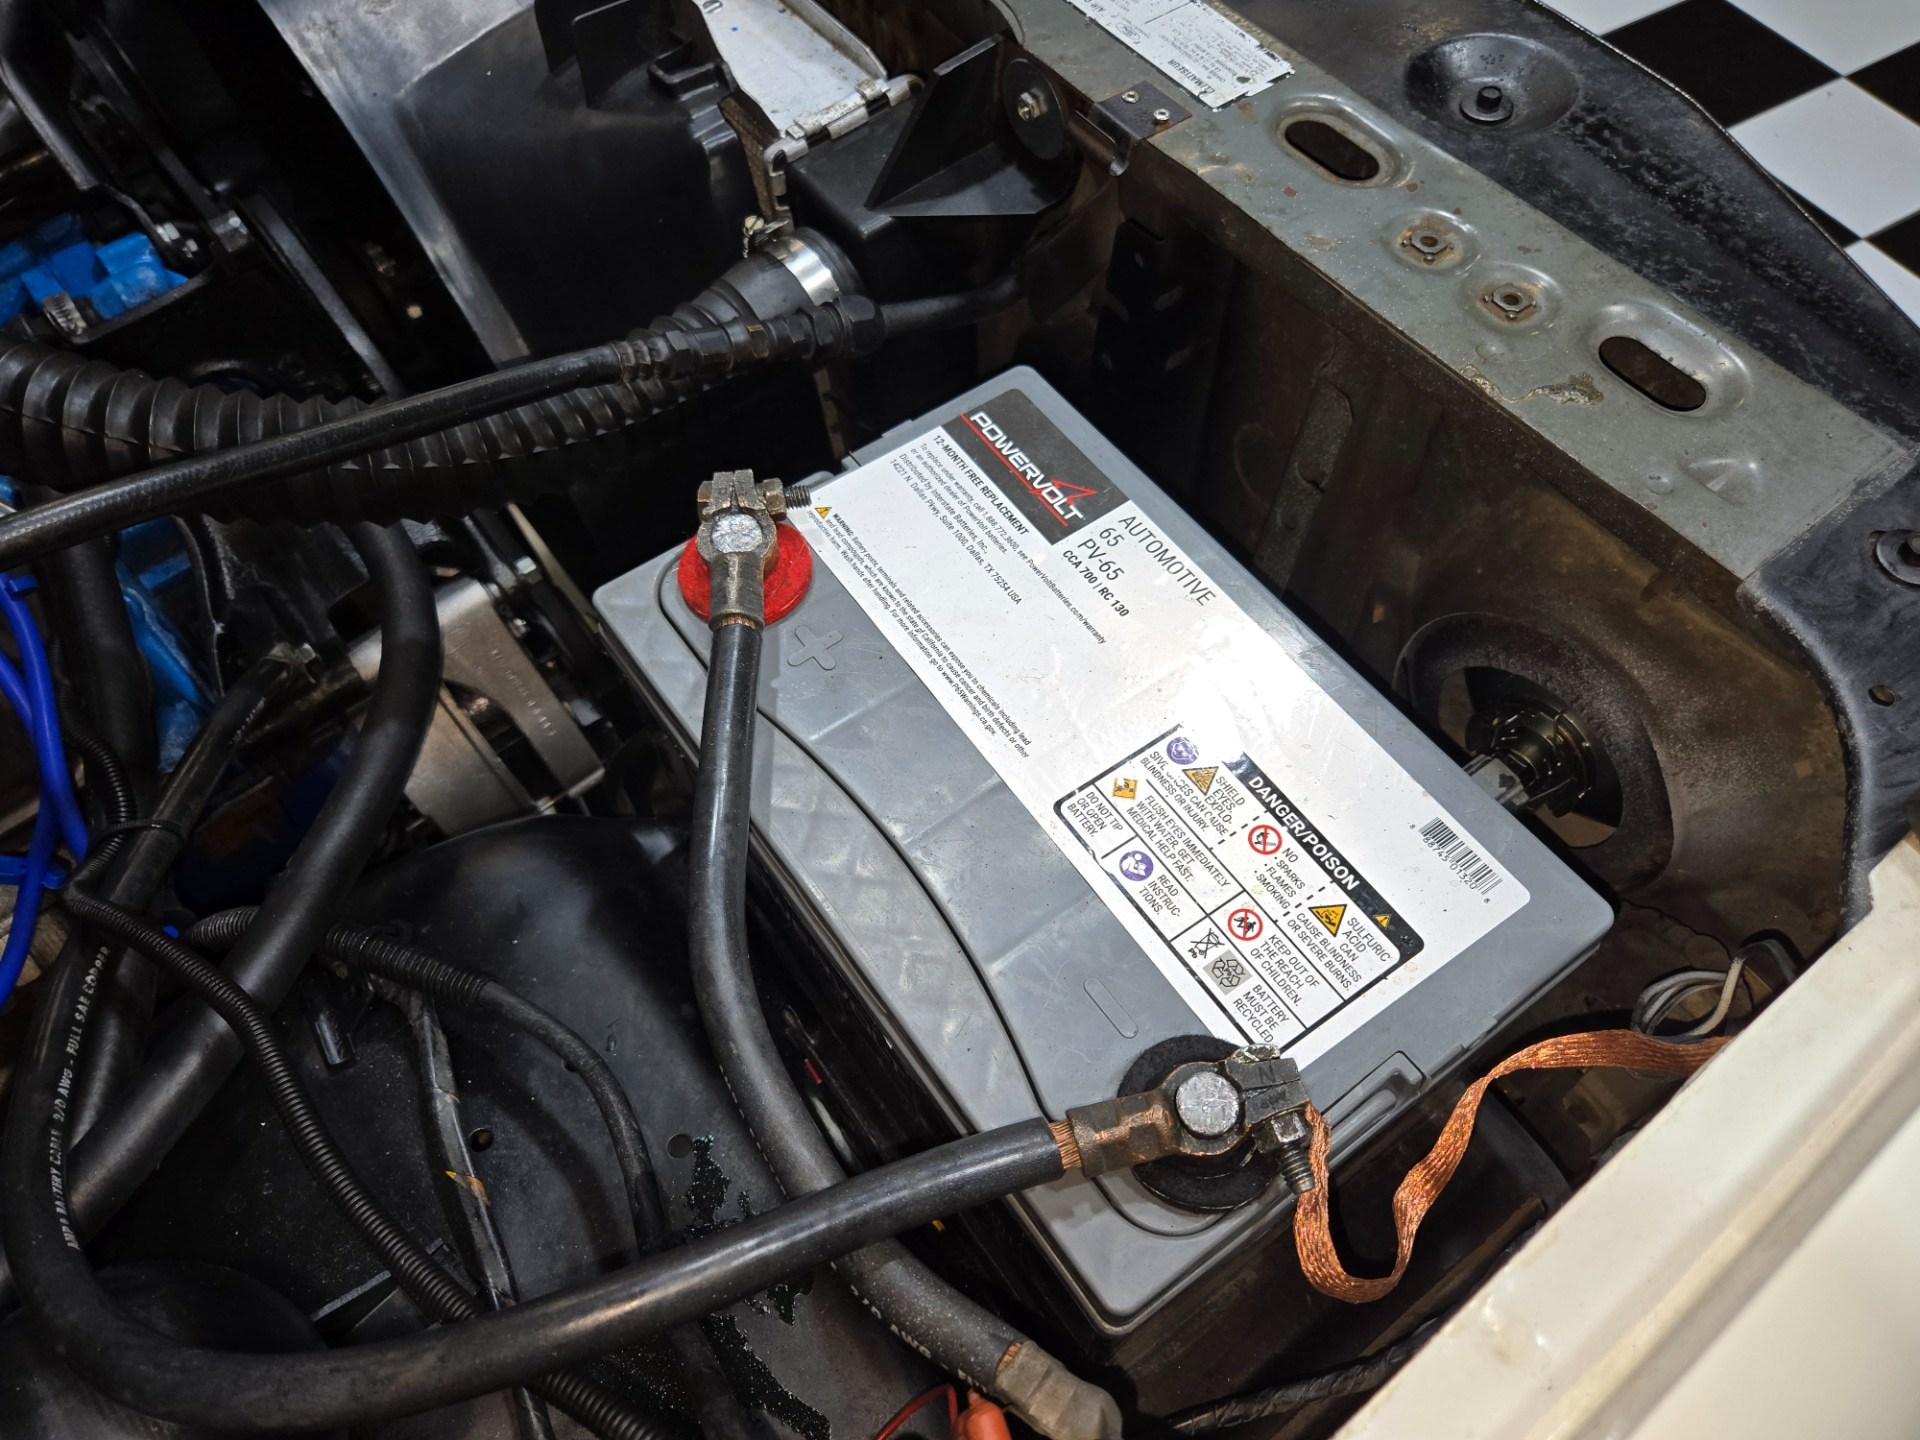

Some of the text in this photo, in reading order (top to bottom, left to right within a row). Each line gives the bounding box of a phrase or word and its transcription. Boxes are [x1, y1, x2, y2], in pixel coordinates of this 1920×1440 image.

[1167, 58, 1216, 95] CLIMATISEUR
[933, 434, 1029, 535] 12-MONTH FREE REPLACEMENT
[970, 412, 1082, 519] POWERVOLT
[898, 453, 929, 483] Distributed
[923, 480, 934, 491] by
[930, 488, 956, 515] Interstate
[952, 513, 978, 542] Batteries,
[909, 447, 1008, 555] or an authorized dealer of PowerVolt batteries.
[889, 458, 1022, 605] 14221 N. Dallas Pkwy, Suite 1000, Dallas, TX 75254 USA
[919, 442, 928, 452] To
[924, 449, 944, 469] replace
[940, 466, 957, 482] under
[953, 480, 975, 504] warranty,
[972, 501, 986, 513] call
[1016, 549, 1029, 561] see
[1025, 558, 1106, 644] PowerVoltBatteries.com/warranty
[1098, 527, 1125, 547] 65
[1077, 537, 1125, 581] PV-65
[1118, 516, 1216, 605] AUTOMOTIVE
[805, 509, 832, 538] reproductive
[839, 549, 854, 564] Wash
[849, 561, 865, 578] hands
[861, 576, 875, 589] after
[871, 587, 891, 611] handling.
[889, 608, 900, 619] For
[896, 617, 910, 632] more
[906, 629, 933, 659] information
[928, 657, 939, 666] go
[935, 663, 944, 672] to
[1062, 549, 1130, 617] CCA 700 RC 130
[824, 518, 837, 529] and
[832, 526, 846, 539] lead
[863, 563, 878, 579] which
[873, 577, 884, 587] are
[881, 584, 897, 603] known
[893, 600, 902, 608] to
[898, 605, 909, 616] the
[905, 614, 919, 629] state
[921, 632, 944, 658] California
[940, 655, 949, 664] to
[945, 662, 961, 679] cause
[958, 676, 976, 695] cancer
[972, 694, 986, 706] and
[980, 703, 995, 718] birth
[991, 716, 1012, 738] defects
[1008, 736, 1018, 744] or
[1013, 742, 1030, 758] other
[832, 512, 1032, 746] WARNING: Battery posts, terminals and related accessories can expose you to chemicals including lead
[1085, 790, 1124, 831] DO NOT TIP
[1139, 756, 1209, 832] BLINDNESS OR INJURY.
[1203, 794, 1233, 824] EXPLO-
[1211, 787, 1236, 813] EYES.
[1215, 775, 1246, 806] SHIELD
[1066, 802, 1098, 837] BATTERY.
[1076, 797, 1108, 830] OR OPEN
[1135, 800, 1196, 865] WITH WATER. GET
[1189, 795, 1229, 836] CAN CAUSE
[1248, 776, 1359, 890] DANGER/POISON
[1125, 806, 1194, 882] MEDICAL HELP FAST.
[1144, 794, 1231, 887] FLUSH EYES IMMEDIATELY
[1281, 846, 1299, 863] NO
[1422, 834, 1451, 862] 88745
[1449, 862, 1480, 890] 01320
[1156, 873, 1179, 897] READ
[1255, 873, 1291, 910] SMOKING
[1265, 866, 1297, 898] FLAMES
[1275, 859, 1306, 890] SPARKS
[1138, 885, 1163, 915] TIONS.
[1147, 879, 1181, 917] INSTRUC-
[1187, 947, 1198, 959] Pb
[1267, 933, 1320, 987] KEEP OUT OF
[1286, 918, 1352, 991] OR SEVERE BURNS.
[1296, 912, 1362, 983] CAUSE BLINDNESS
[1338, 942, 1359, 962] CAN
[1341, 929, 1367, 953] ACID
[1346, 917, 1391, 962] SULFURIC
[82, 946, 111, 995] COPPER
[1249, 947, 1302, 1007] OF CHILDREN.
[1259, 940, 1305, 990] THE REACH
[74, 995, 91, 1023] SAE
[1232, 997, 1274, 1046] RECYCLED
[1242, 990, 1280, 1031] MUST BE
[1252, 983, 1290, 1023] BATTERY
[65, 1026, 82, 1056] FULL
[57, 1068, 73, 1098] AWG
